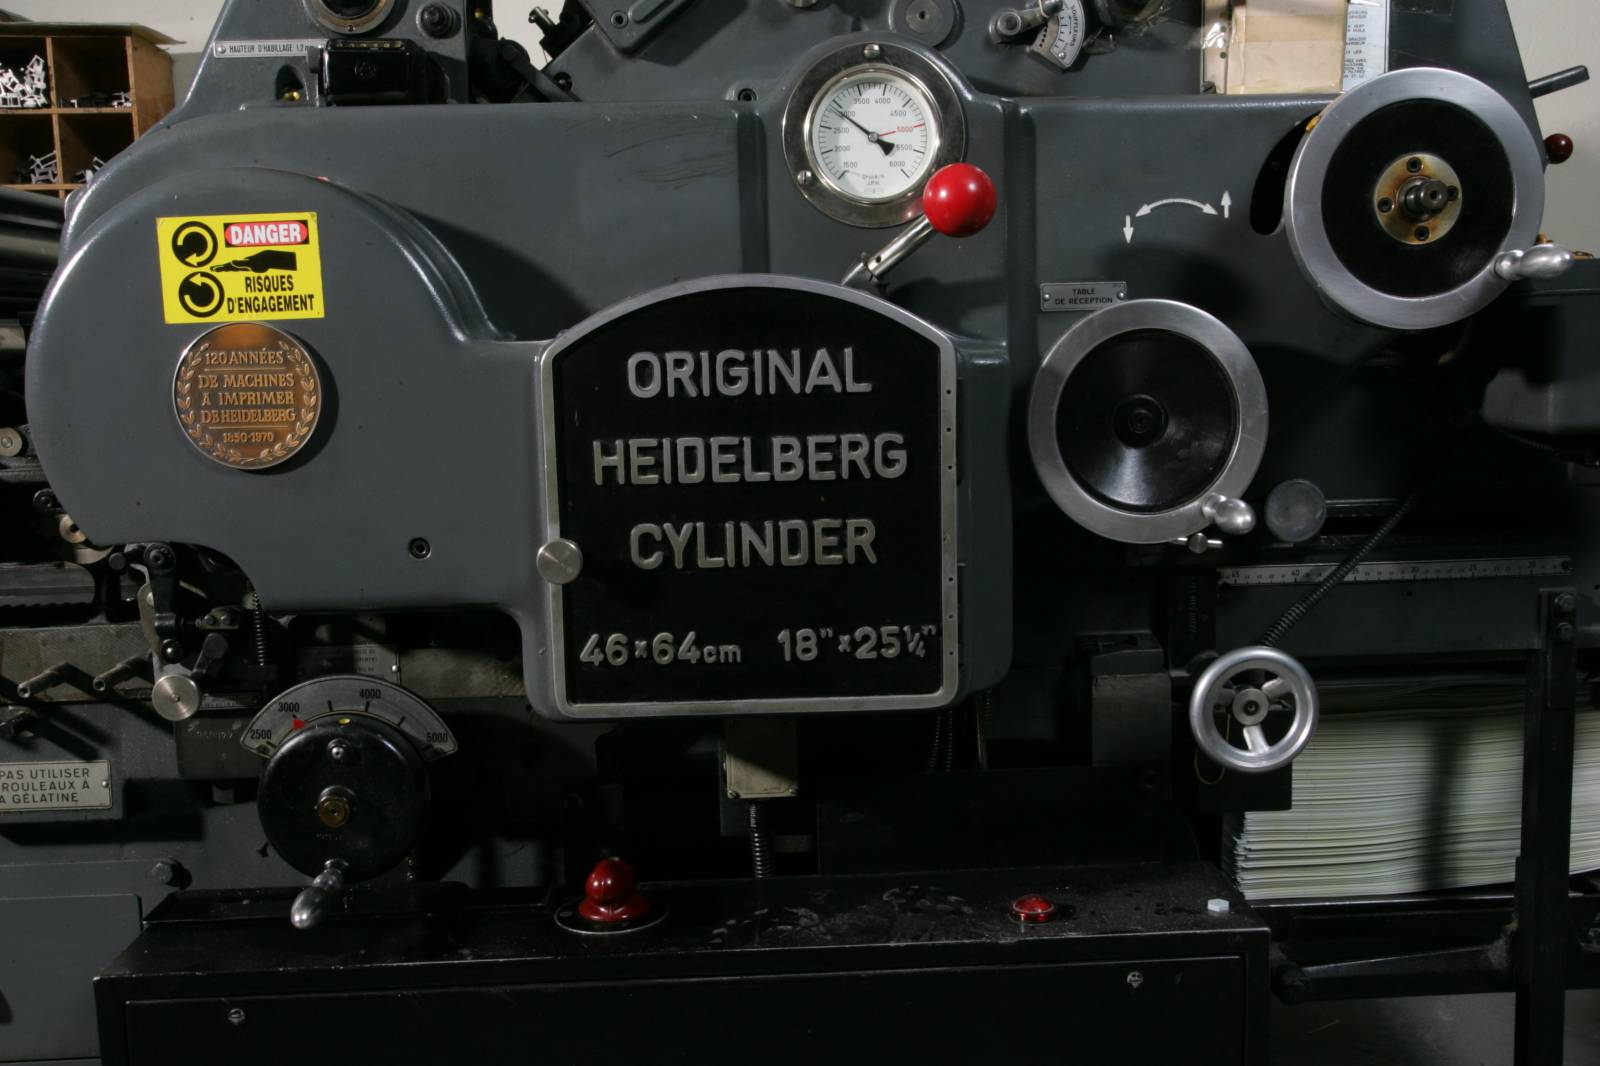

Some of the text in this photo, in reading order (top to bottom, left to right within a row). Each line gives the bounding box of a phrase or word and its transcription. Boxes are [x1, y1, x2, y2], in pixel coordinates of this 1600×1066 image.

[229, 45, 255, 54] HAUTEUR
[258, 43, 293, 53] D'HABILLAGE
[230, 223, 302, 246] DANGER
[244, 274, 294, 294] RISQUES
[227, 294, 315, 314] D'ENGAGEMENT
[204, 347, 284, 365] 120 ANNÉES
[626, 346, 873, 400] ORIGINAL
[198, 373, 295, 389] DE MACHINES
[219, 391, 296, 405] IMPRIMER
[200, 407, 296, 424] DE HEIDELBERG
[223, 432, 274, 442] 1850-1970
[592, 431, 908, 487] HEIDELBERG
[629, 517, 879, 571] CYLINDER
[359, 688, 381, 699] 4000
[278, 702, 300, 713] 3000
[250, 729, 272, 740] 2500
[426, 732, 448, 744] 5000
[0, 768, 90, 780] PAS UTILISER
[2, 781, 76, 792] ROULEAUX
[12, 792, 79, 804] GÉLATINE
